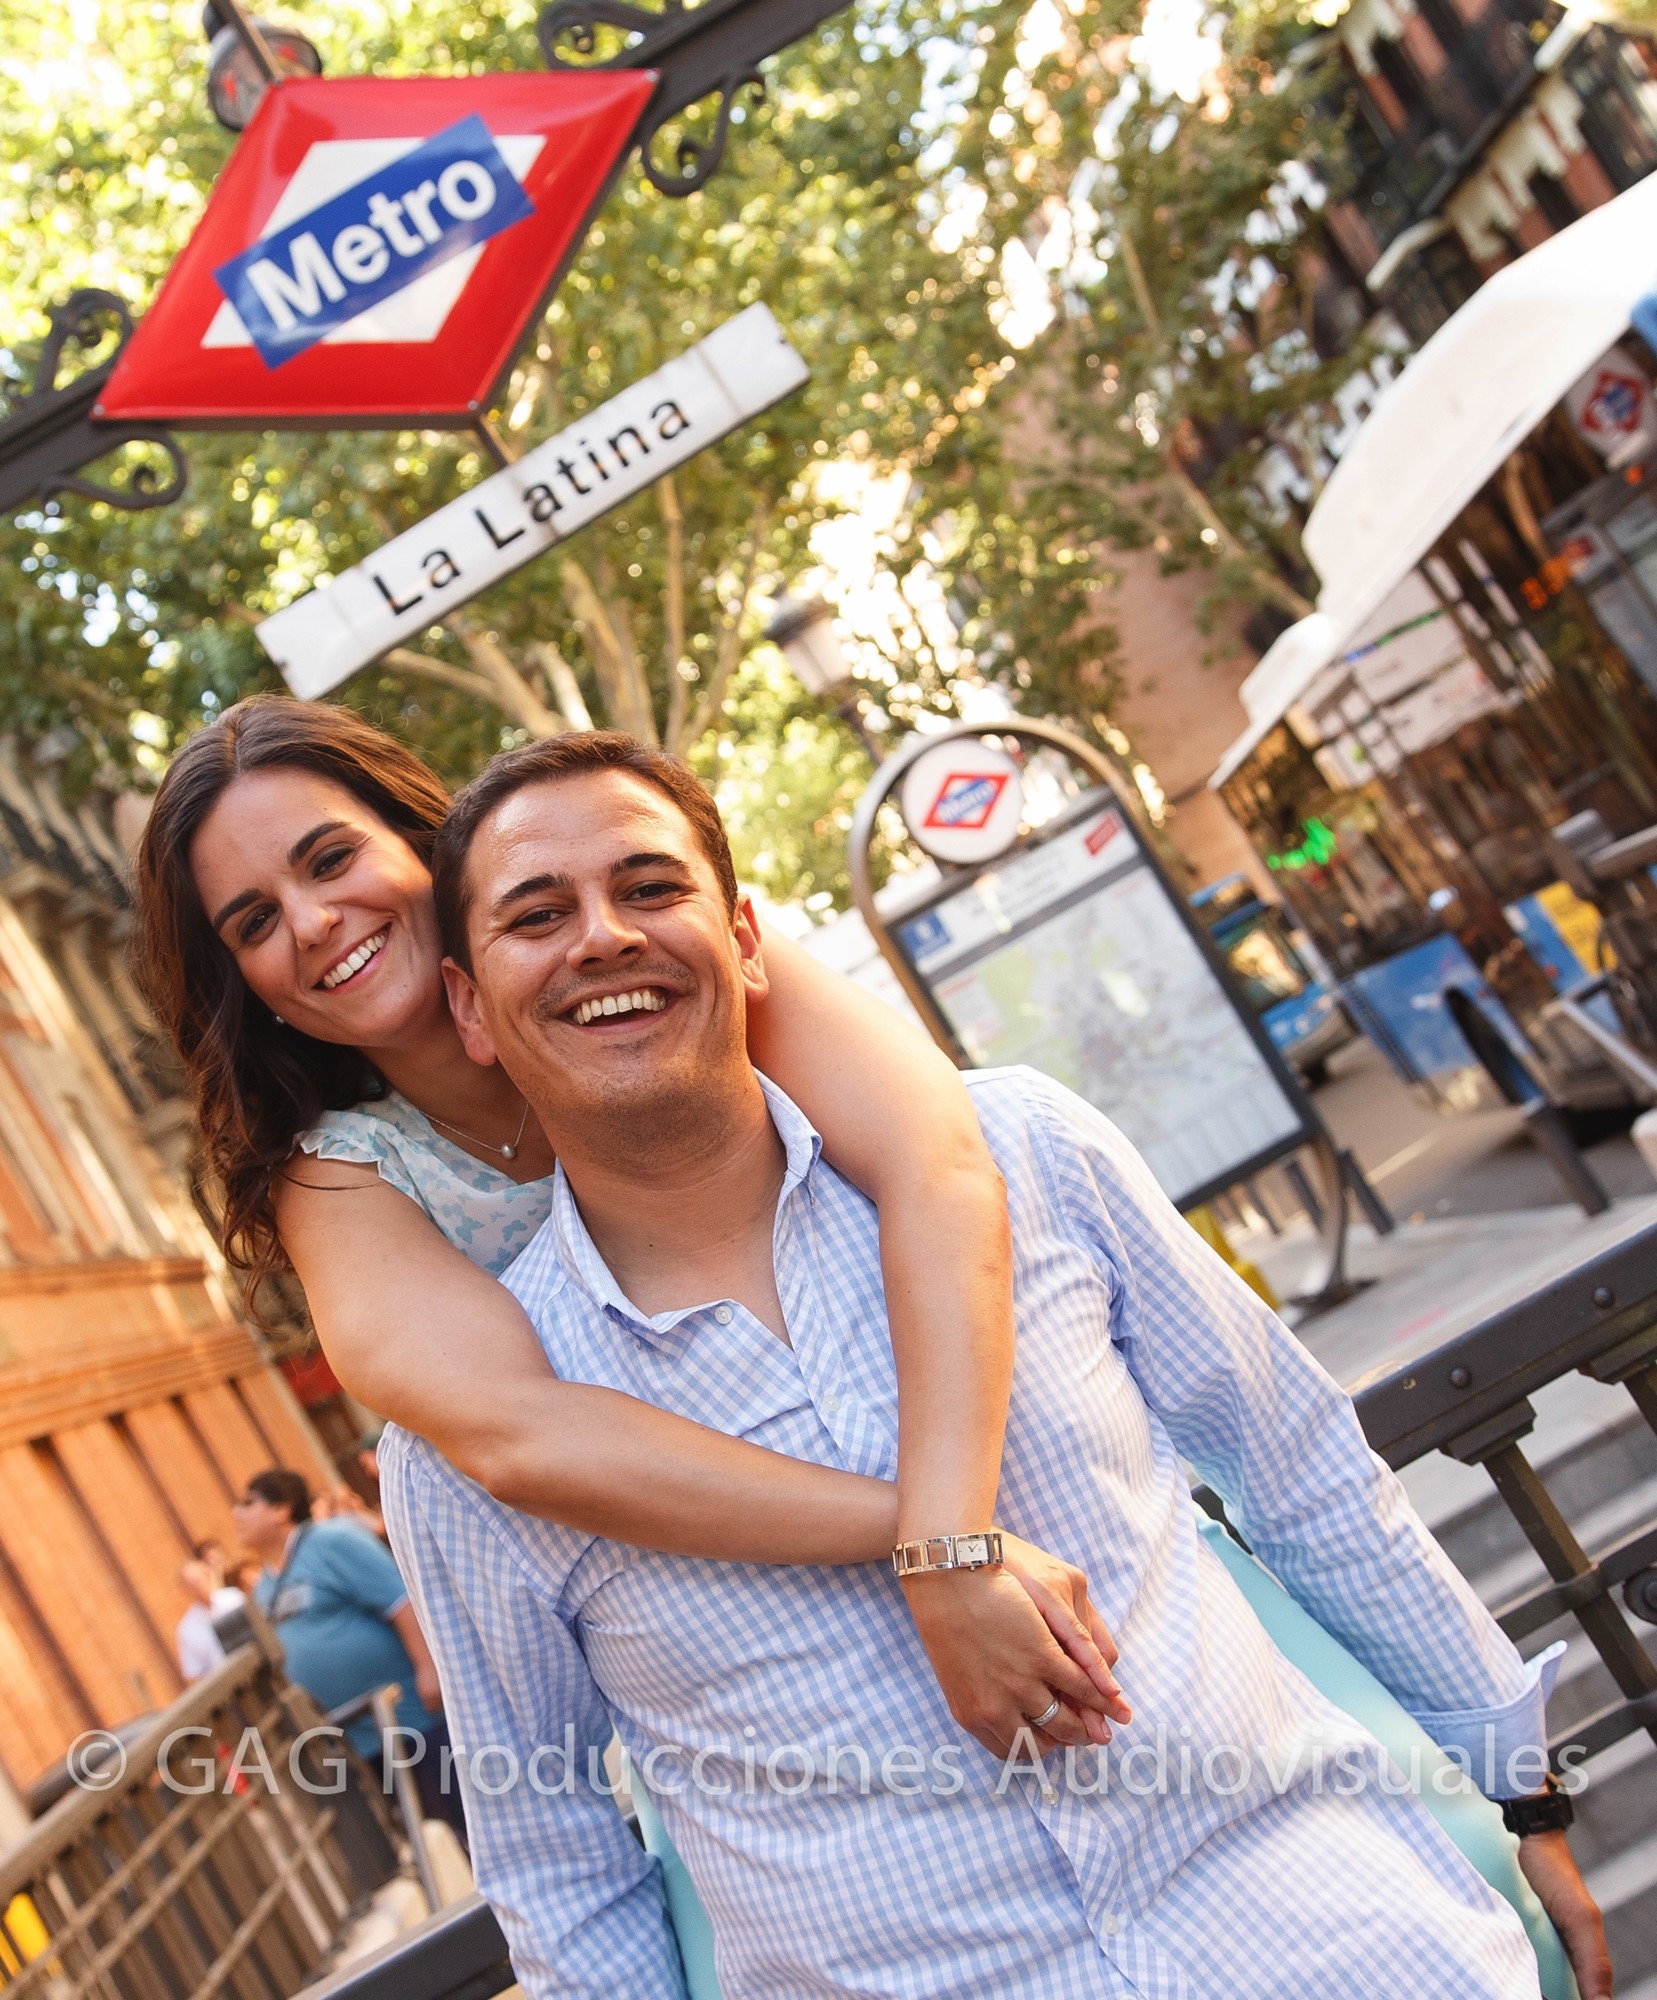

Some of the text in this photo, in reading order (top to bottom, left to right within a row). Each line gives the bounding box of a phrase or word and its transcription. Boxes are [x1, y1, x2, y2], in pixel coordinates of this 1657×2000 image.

[245, 159, 497, 332] Metro
[373, 393, 692, 616] La Latina
